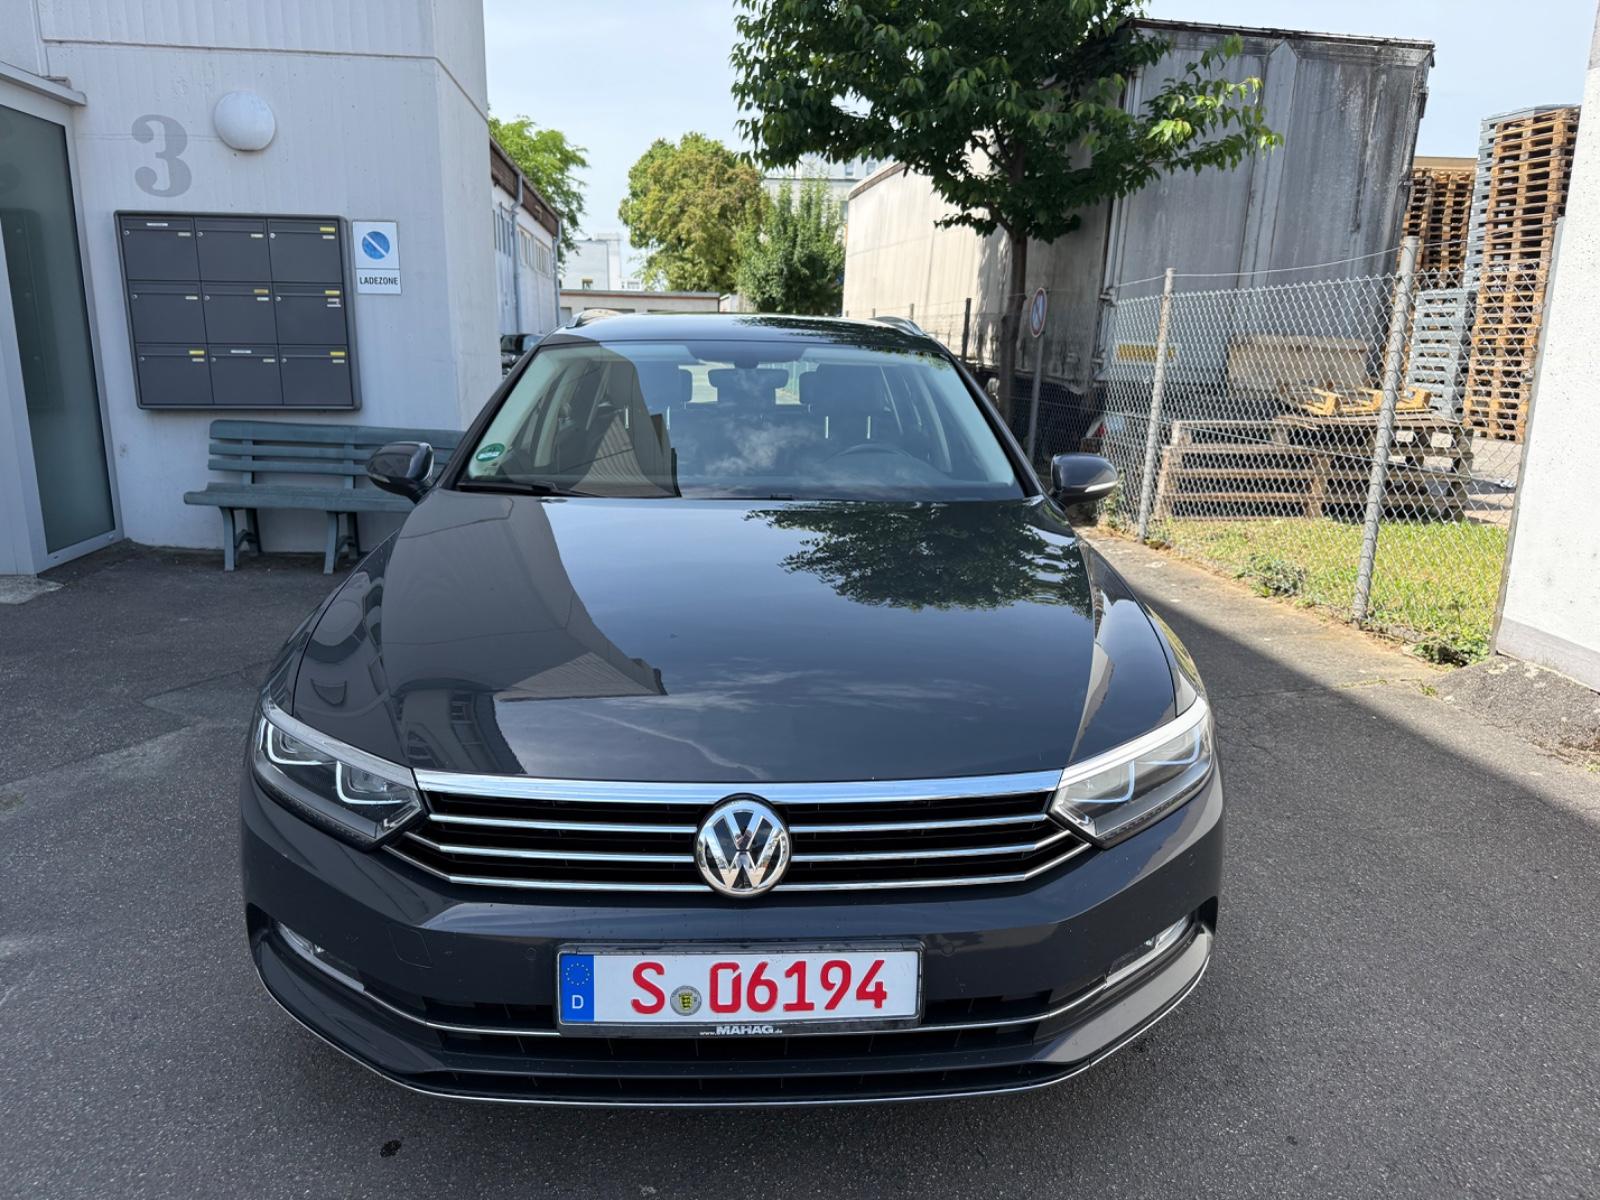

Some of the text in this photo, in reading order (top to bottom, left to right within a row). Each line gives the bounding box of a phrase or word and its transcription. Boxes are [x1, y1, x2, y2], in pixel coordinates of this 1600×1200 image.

[131, 114, 192, 198] 3
[359, 276, 399, 286] LADEZONE
[571, 994, 584, 1009] D
[630, 961, 666, 1015] S
[709, 959, 888, 1014] 06194
